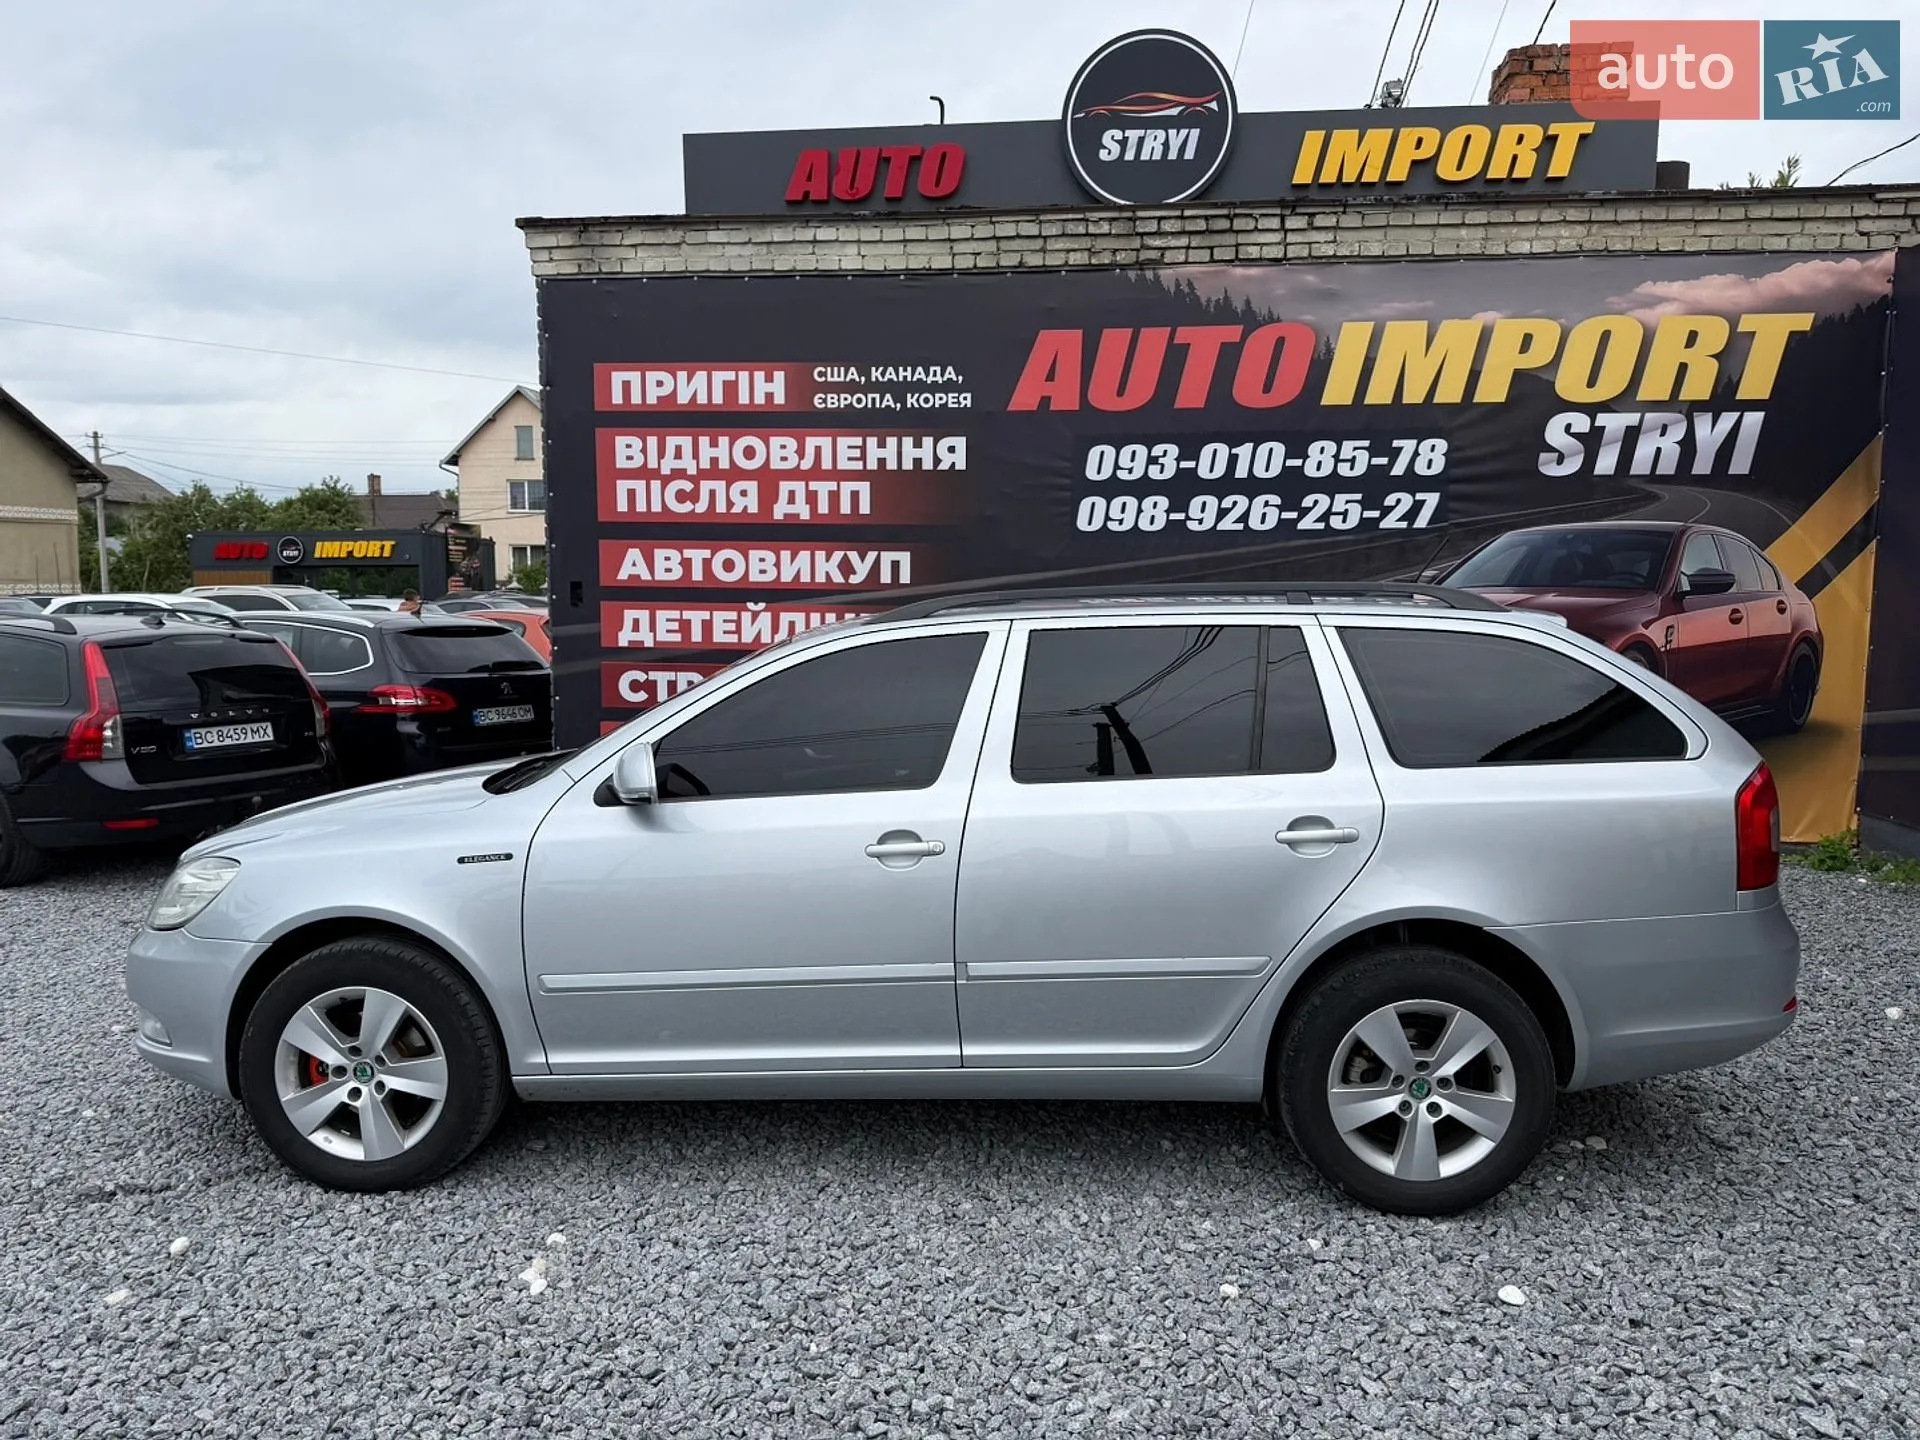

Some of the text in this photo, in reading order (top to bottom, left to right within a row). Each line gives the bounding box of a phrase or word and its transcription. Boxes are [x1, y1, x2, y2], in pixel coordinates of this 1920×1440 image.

[784, 121, 1596, 203] AUTO IMPORT
[1098, 127, 1201, 162] STRYI
[813, 365, 964, 385] США, КАНАДА,
[1006, 312, 1815, 412] AUTO IMPORT
[610, 370, 786, 406] ПРИГІН
[813, 392, 972, 412] ЄВРОПА, КОРЕЯ
[614, 435, 968, 476] ВІДНОВЛЕННЯ
[1084, 438, 1449, 481] 093-010-85-78
[1537, 410, 1766, 478] STRYI
[616, 478, 872, 521] ПІСЛЯ ДТП
[1075, 492, 1441, 533] 098-926-25-27
[313, 540, 396, 559] IMPORT
[616, 547, 912, 585] АВТОВИКУП
[190, 708, 269, 719] VOLVO
[193, 730, 215, 746] BC
[217, 726, 248, 743] 8459
[251, 724, 272, 740] MX
